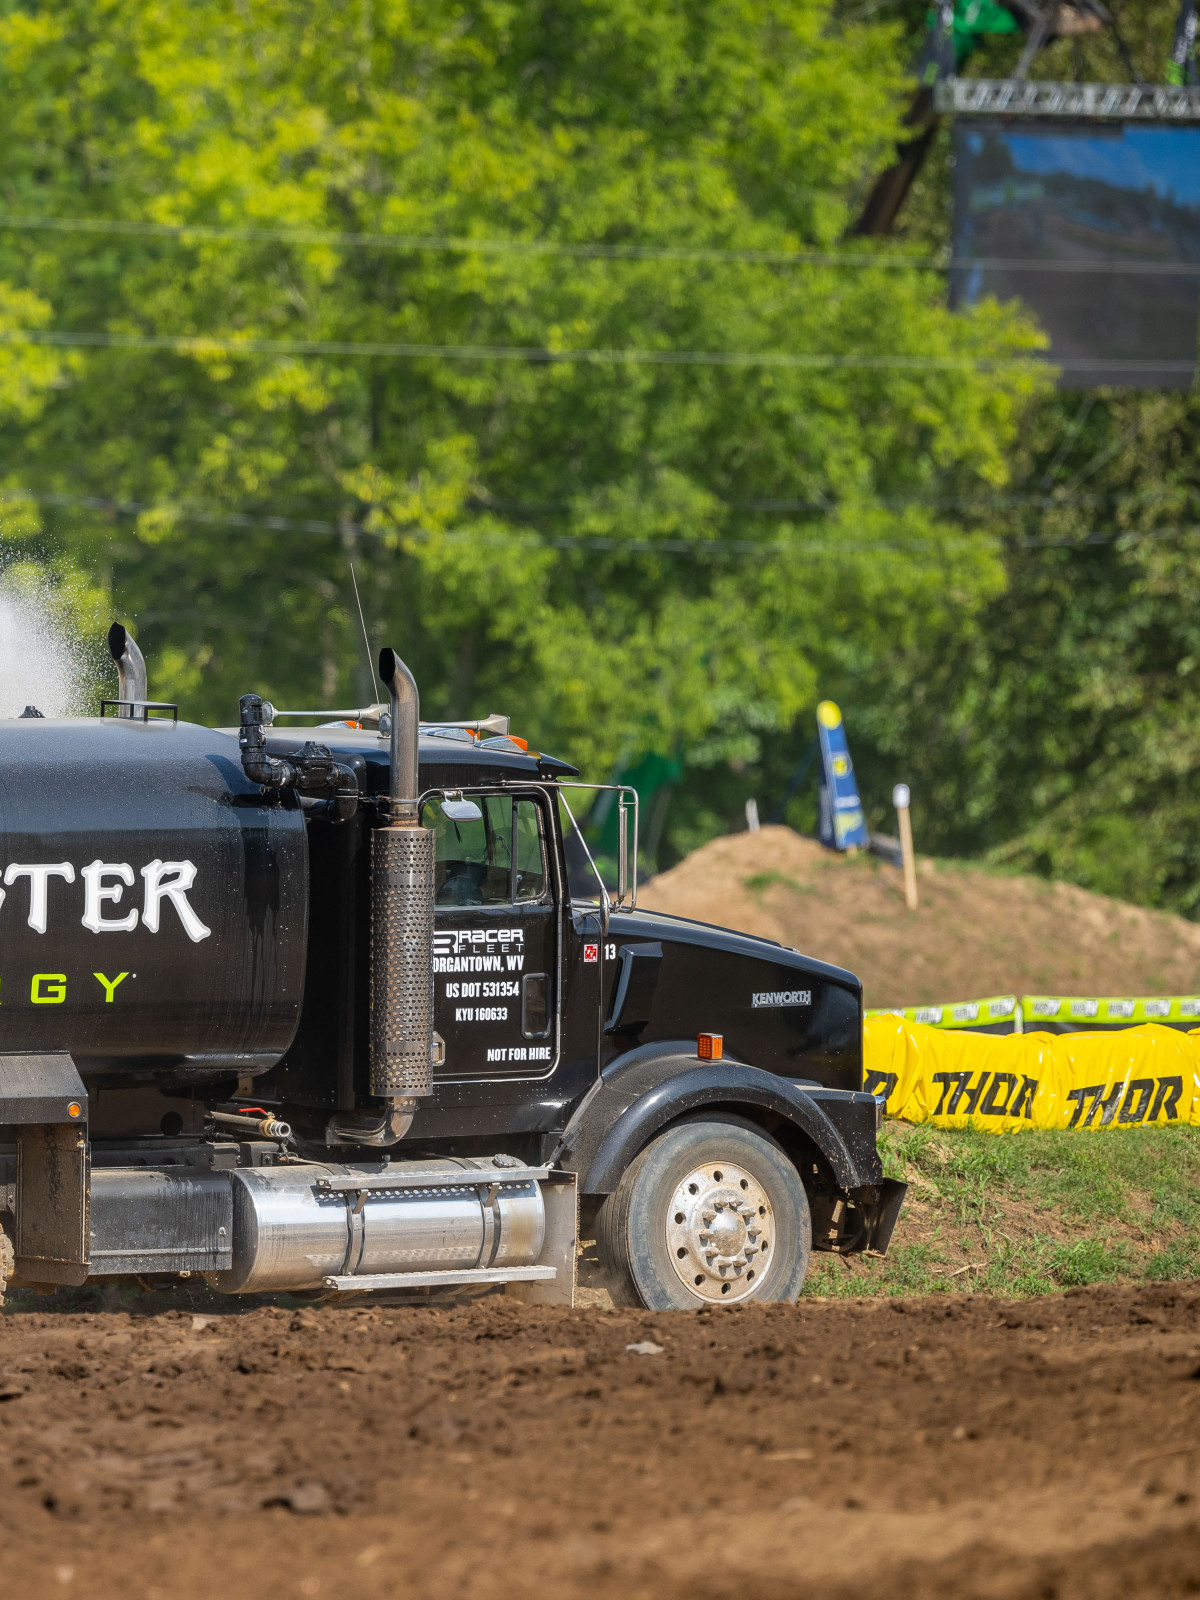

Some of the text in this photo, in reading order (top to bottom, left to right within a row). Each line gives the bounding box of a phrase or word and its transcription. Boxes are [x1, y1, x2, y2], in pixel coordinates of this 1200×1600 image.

[458, 944, 524, 954] FLEET
[604, 943, 617, 960] 13
[433, 955, 524, 973] ORGANTOWN, WV
[445, 981, 519, 998] US DOT 531354
[751, 990, 812, 1006] KENWORTH
[455, 1007, 508, 1021] KYU 160633
[487, 1046, 552, 1062] NOT FOR HIRE
[1065, 1075, 1183, 1129] THOR
